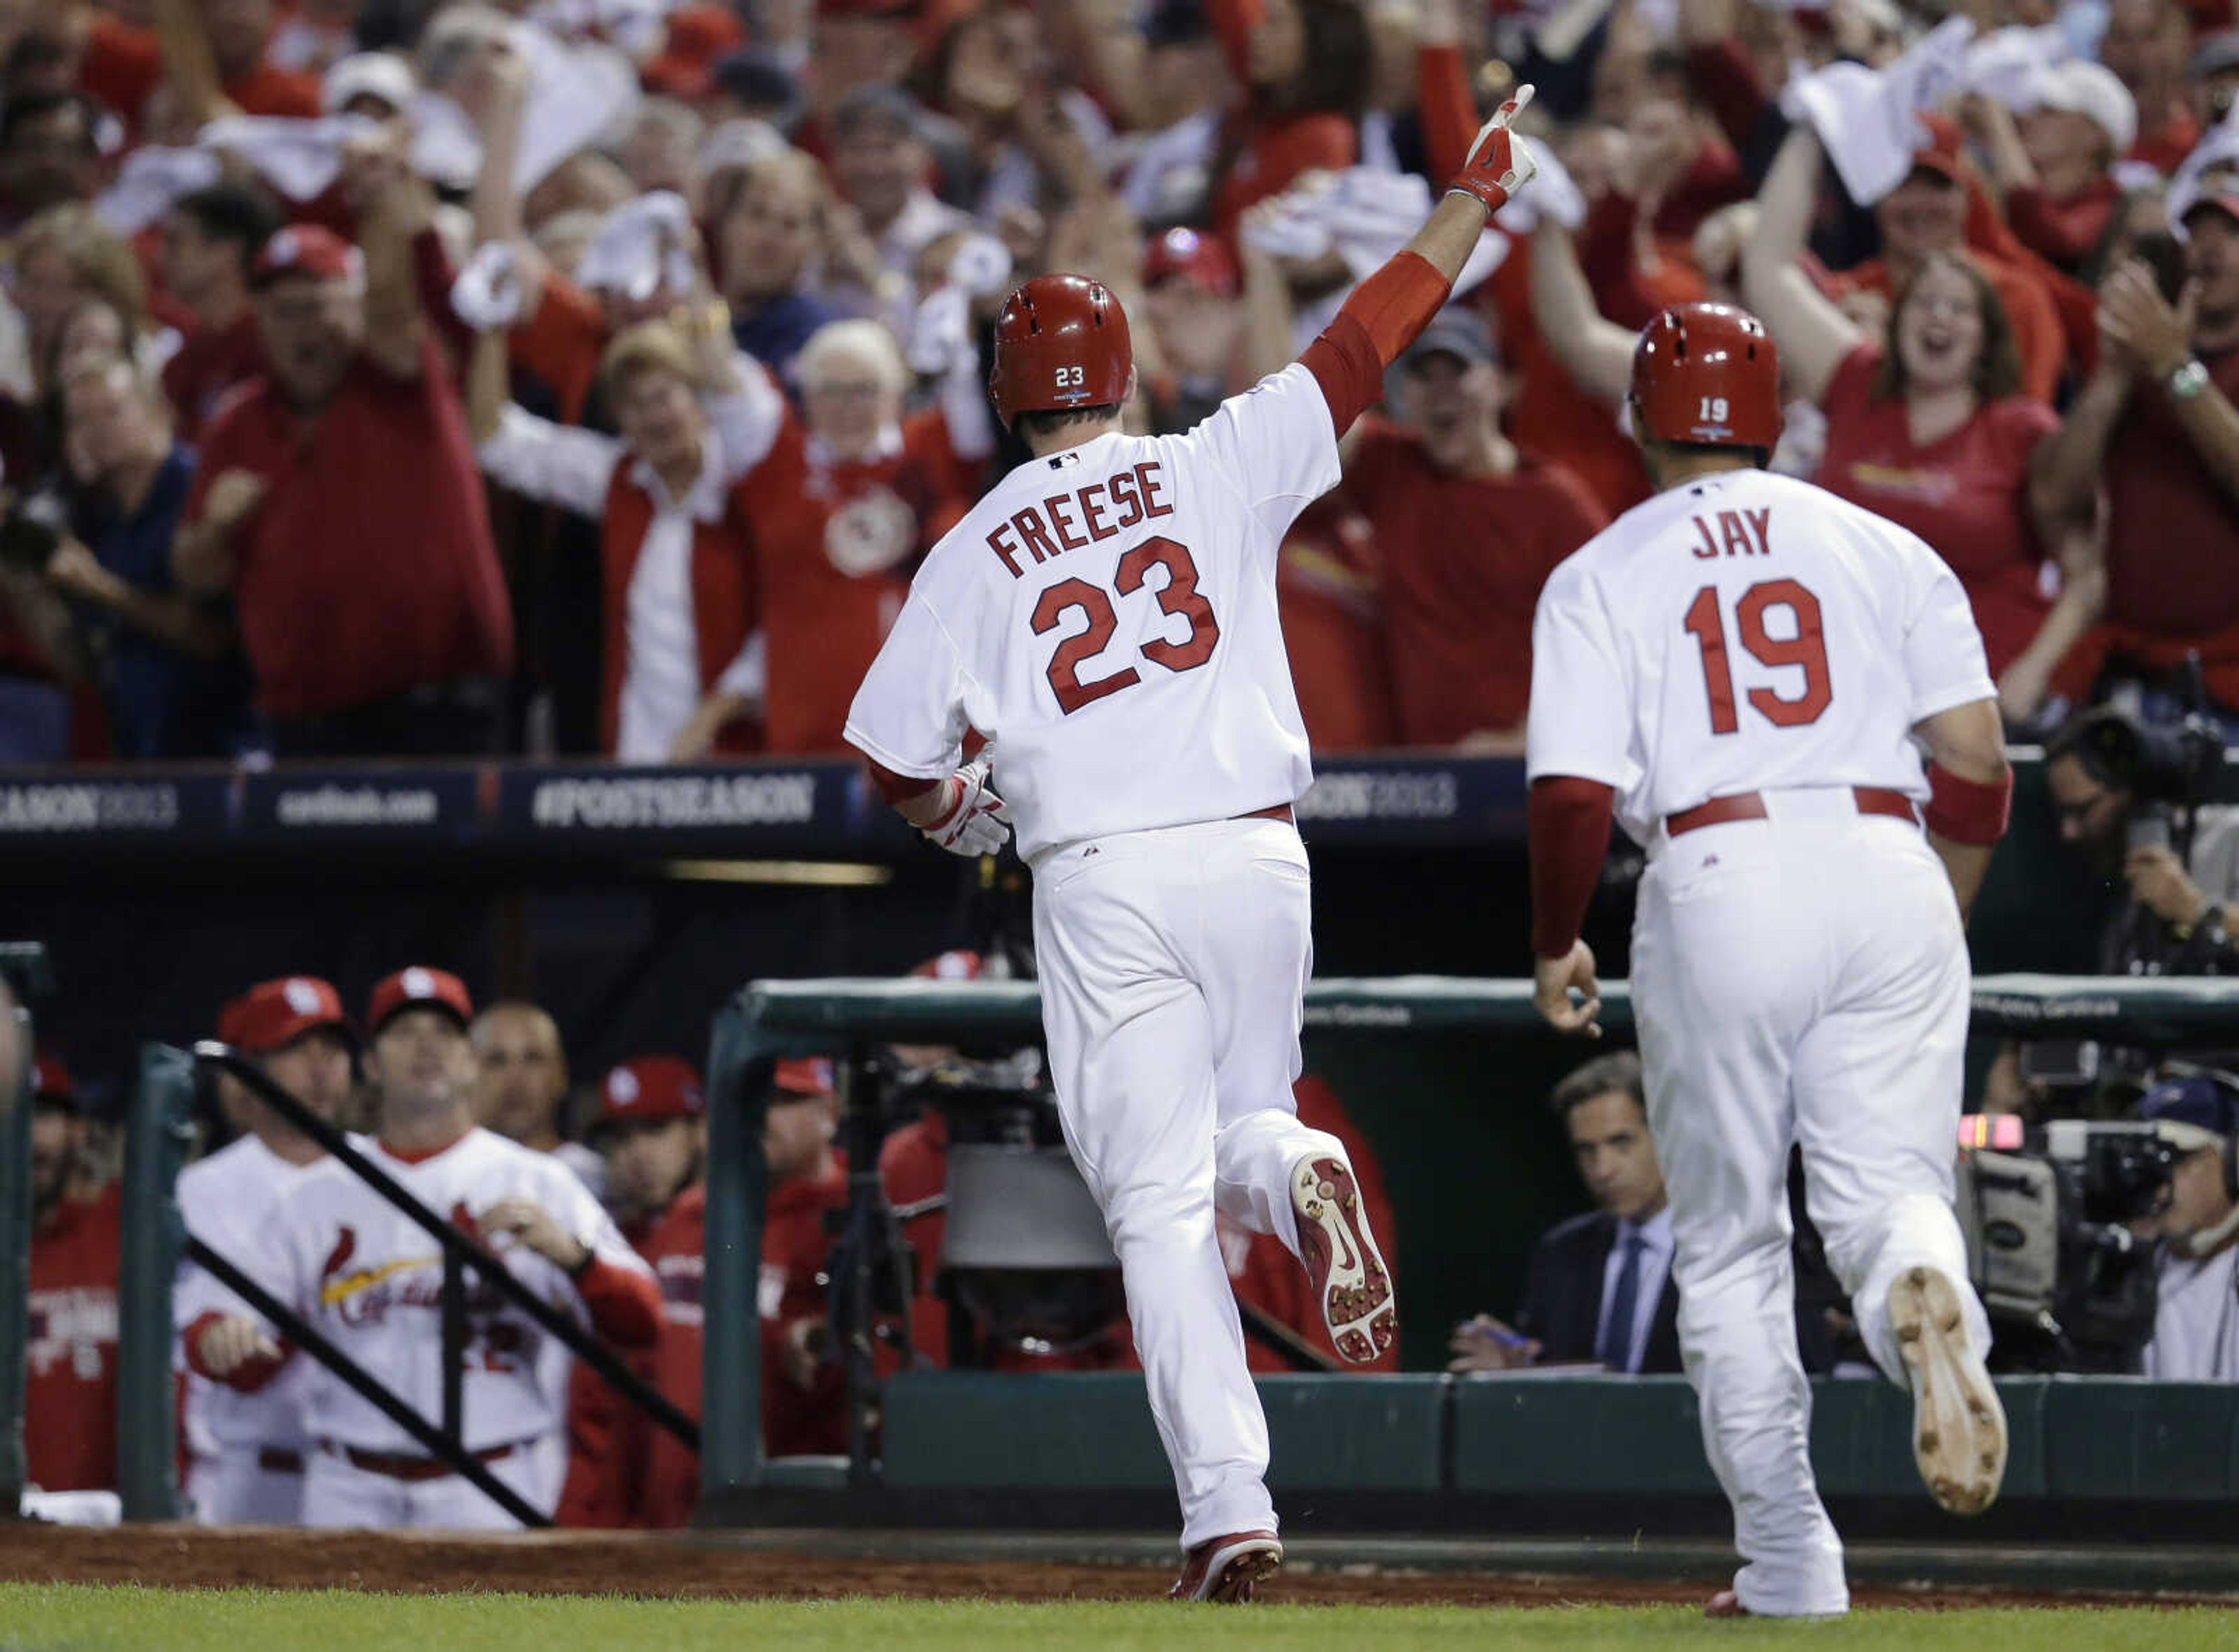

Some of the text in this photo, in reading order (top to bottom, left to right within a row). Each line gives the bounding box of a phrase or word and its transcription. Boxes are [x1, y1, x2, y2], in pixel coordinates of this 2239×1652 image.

[1056, 366, 1085, 388] 23
[1699, 396, 1729, 423] 19
[985, 462, 1173, 579] FREESE
[1692, 508, 1770, 559] JAY
[1030, 536, 1220, 716] 23
[1683, 578, 1834, 735] 19
[532, 773, 815, 828] #POSTSEASON
